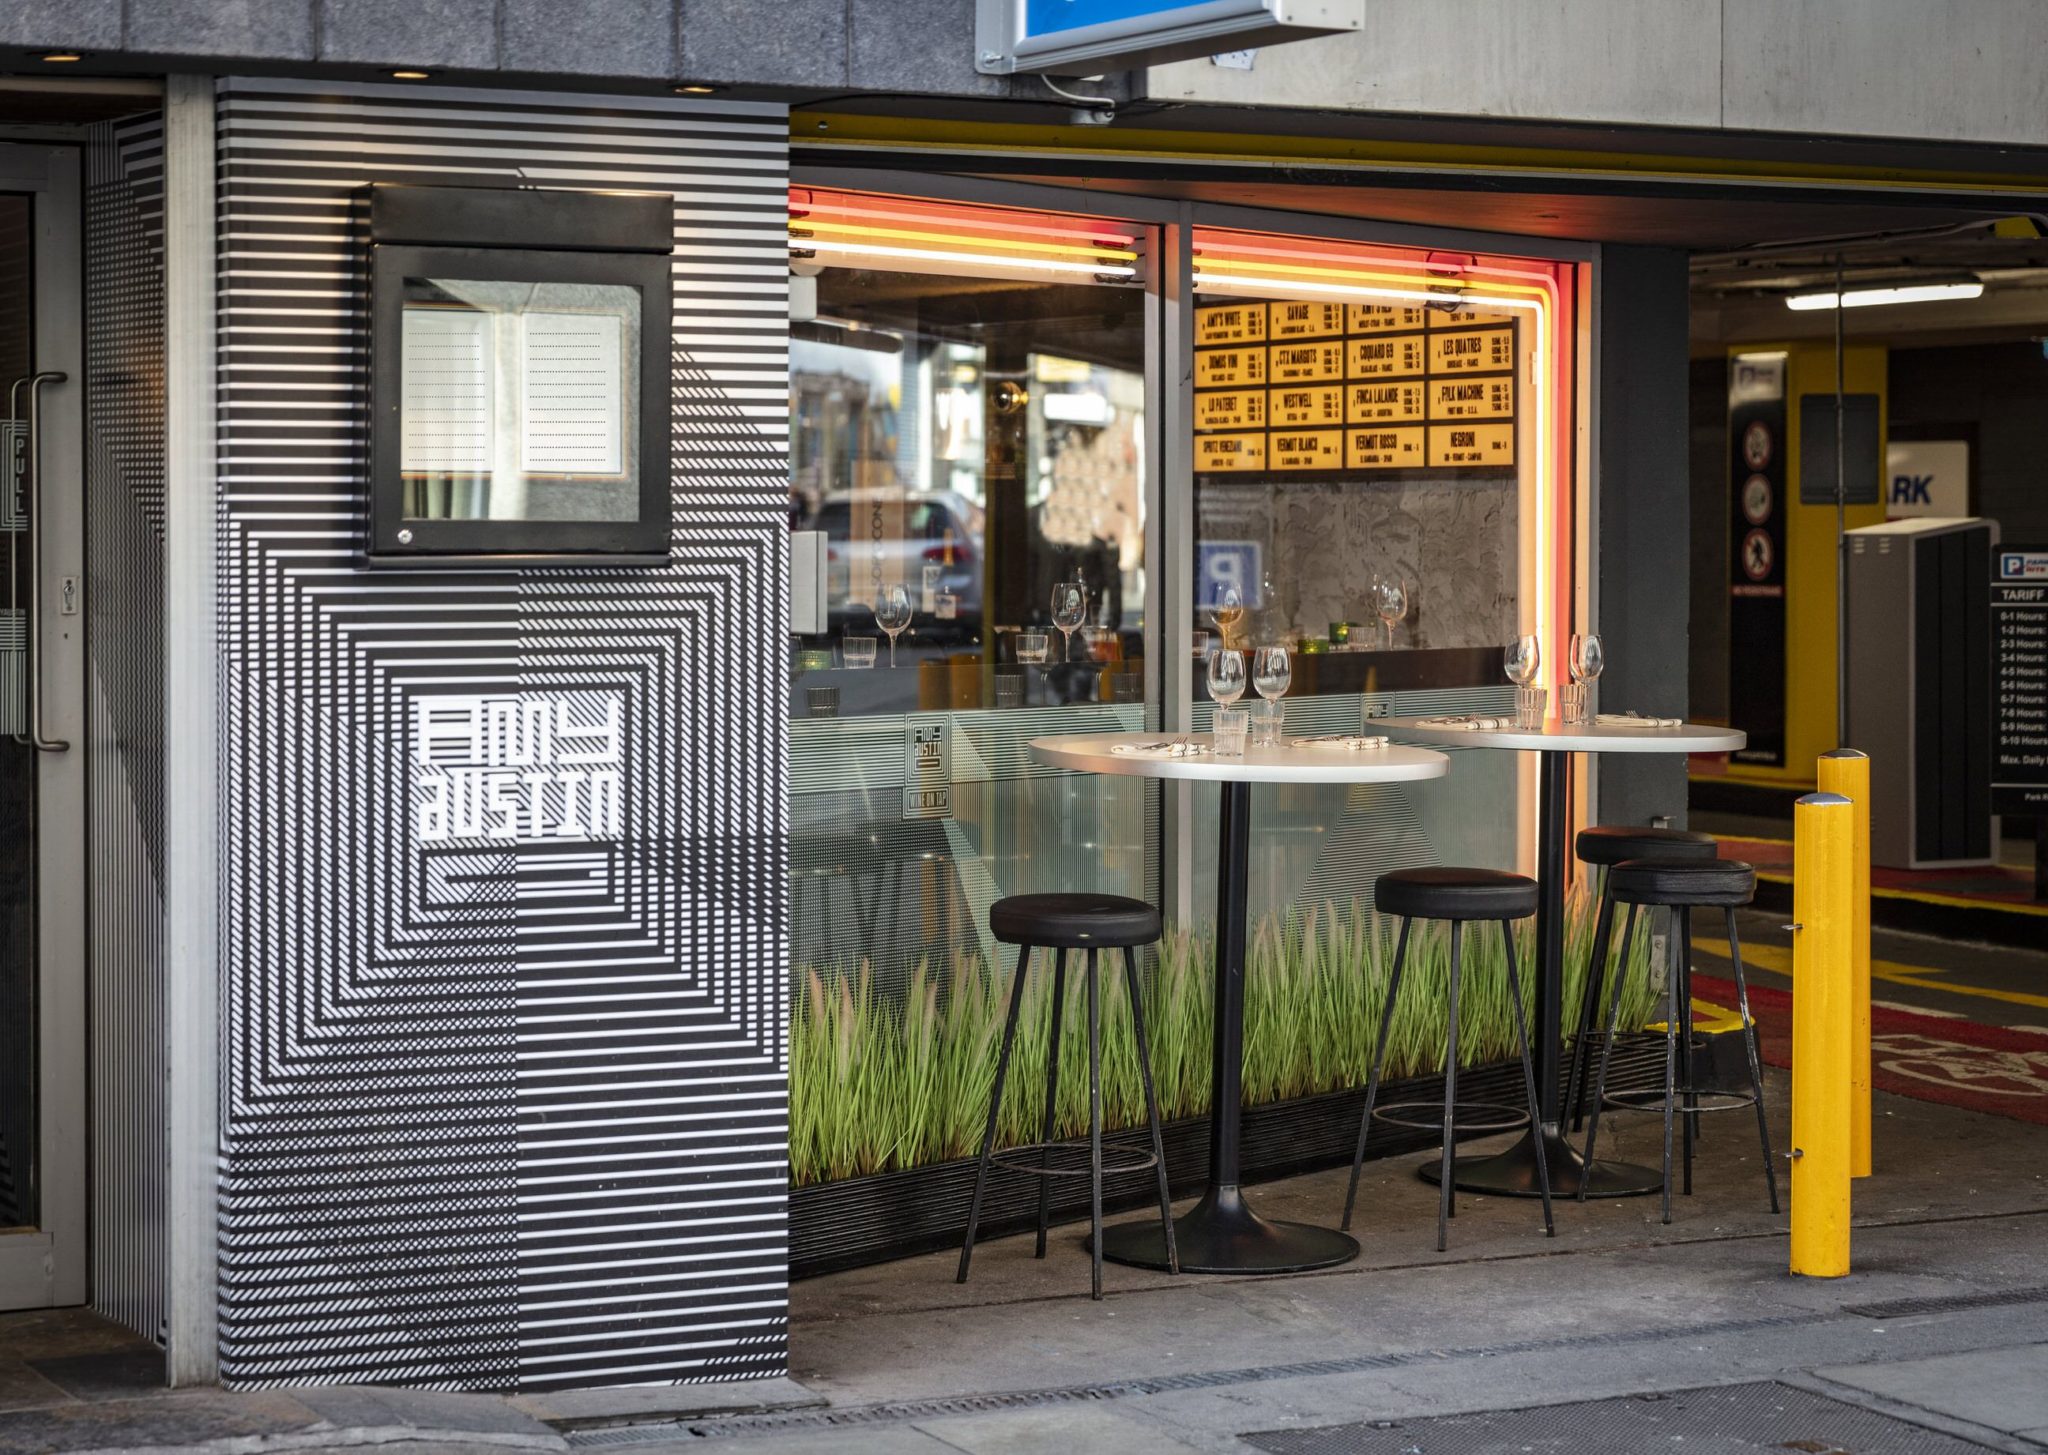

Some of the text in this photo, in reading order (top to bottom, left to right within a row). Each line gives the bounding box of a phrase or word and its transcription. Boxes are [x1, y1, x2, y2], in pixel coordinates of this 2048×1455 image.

[1207, 312, 1223, 327] AMY'S
[1224, 311, 1241, 326] WHITE
[1287, 304, 1309, 321] SAVAGE
[1360, 344, 1385, 361] COQUARD
[1386, 342, 1393, 359] 69
[1443, 339, 1453, 355] LES
[1455, 337, 1482, 356] QUATRES
[1356, 389, 1373, 404] FINCA
[1374, 388, 1398, 403] LALANDE
[1457, 384, 1484, 400] MACHINE
[1283, 393, 1312, 408] WESTWELL
[1277, 438, 1297, 452] VERMUT
[1298, 437, 1318, 451] BLANCO
[1355, 435, 1378, 450] VERMUT
[1379, 433, 1397, 449] ROSSO
[1450, 431, 1475, 447] NEGRONI
[15, 438, 25, 513] PULL
[1886, 474, 1934, 505] RK
[2002, 589, 2045, 601] TARIFF
[2016, 612, 2047, 621] Hours:
[2000, 626, 2047, 635] 1-2 Hours:
[2000, 640, 2047, 649] 2-3 Hours:
[2016, 654, 2047, 662] Hours:
[2000, 667, 2047, 676] 4-5 Hours:
[2016, 680, 2047, 690] Hours:
[2000, 695, 2047, 704] 6-7 Hours:
[2016, 708, 2047, 718] Hours:
[418, 699, 619, 767] AMY
[915, 727, 941, 741] AMY
[2016, 722, 2047, 732] Hours:
[914, 741, 941, 756] AUSTIN
[2000, 736, 2020, 746] 9-10
[2000, 755, 2046, 767] Max. Daily
[418, 771, 619, 842] AUSTIN
[910, 791, 946, 808] WINE ON TAP
